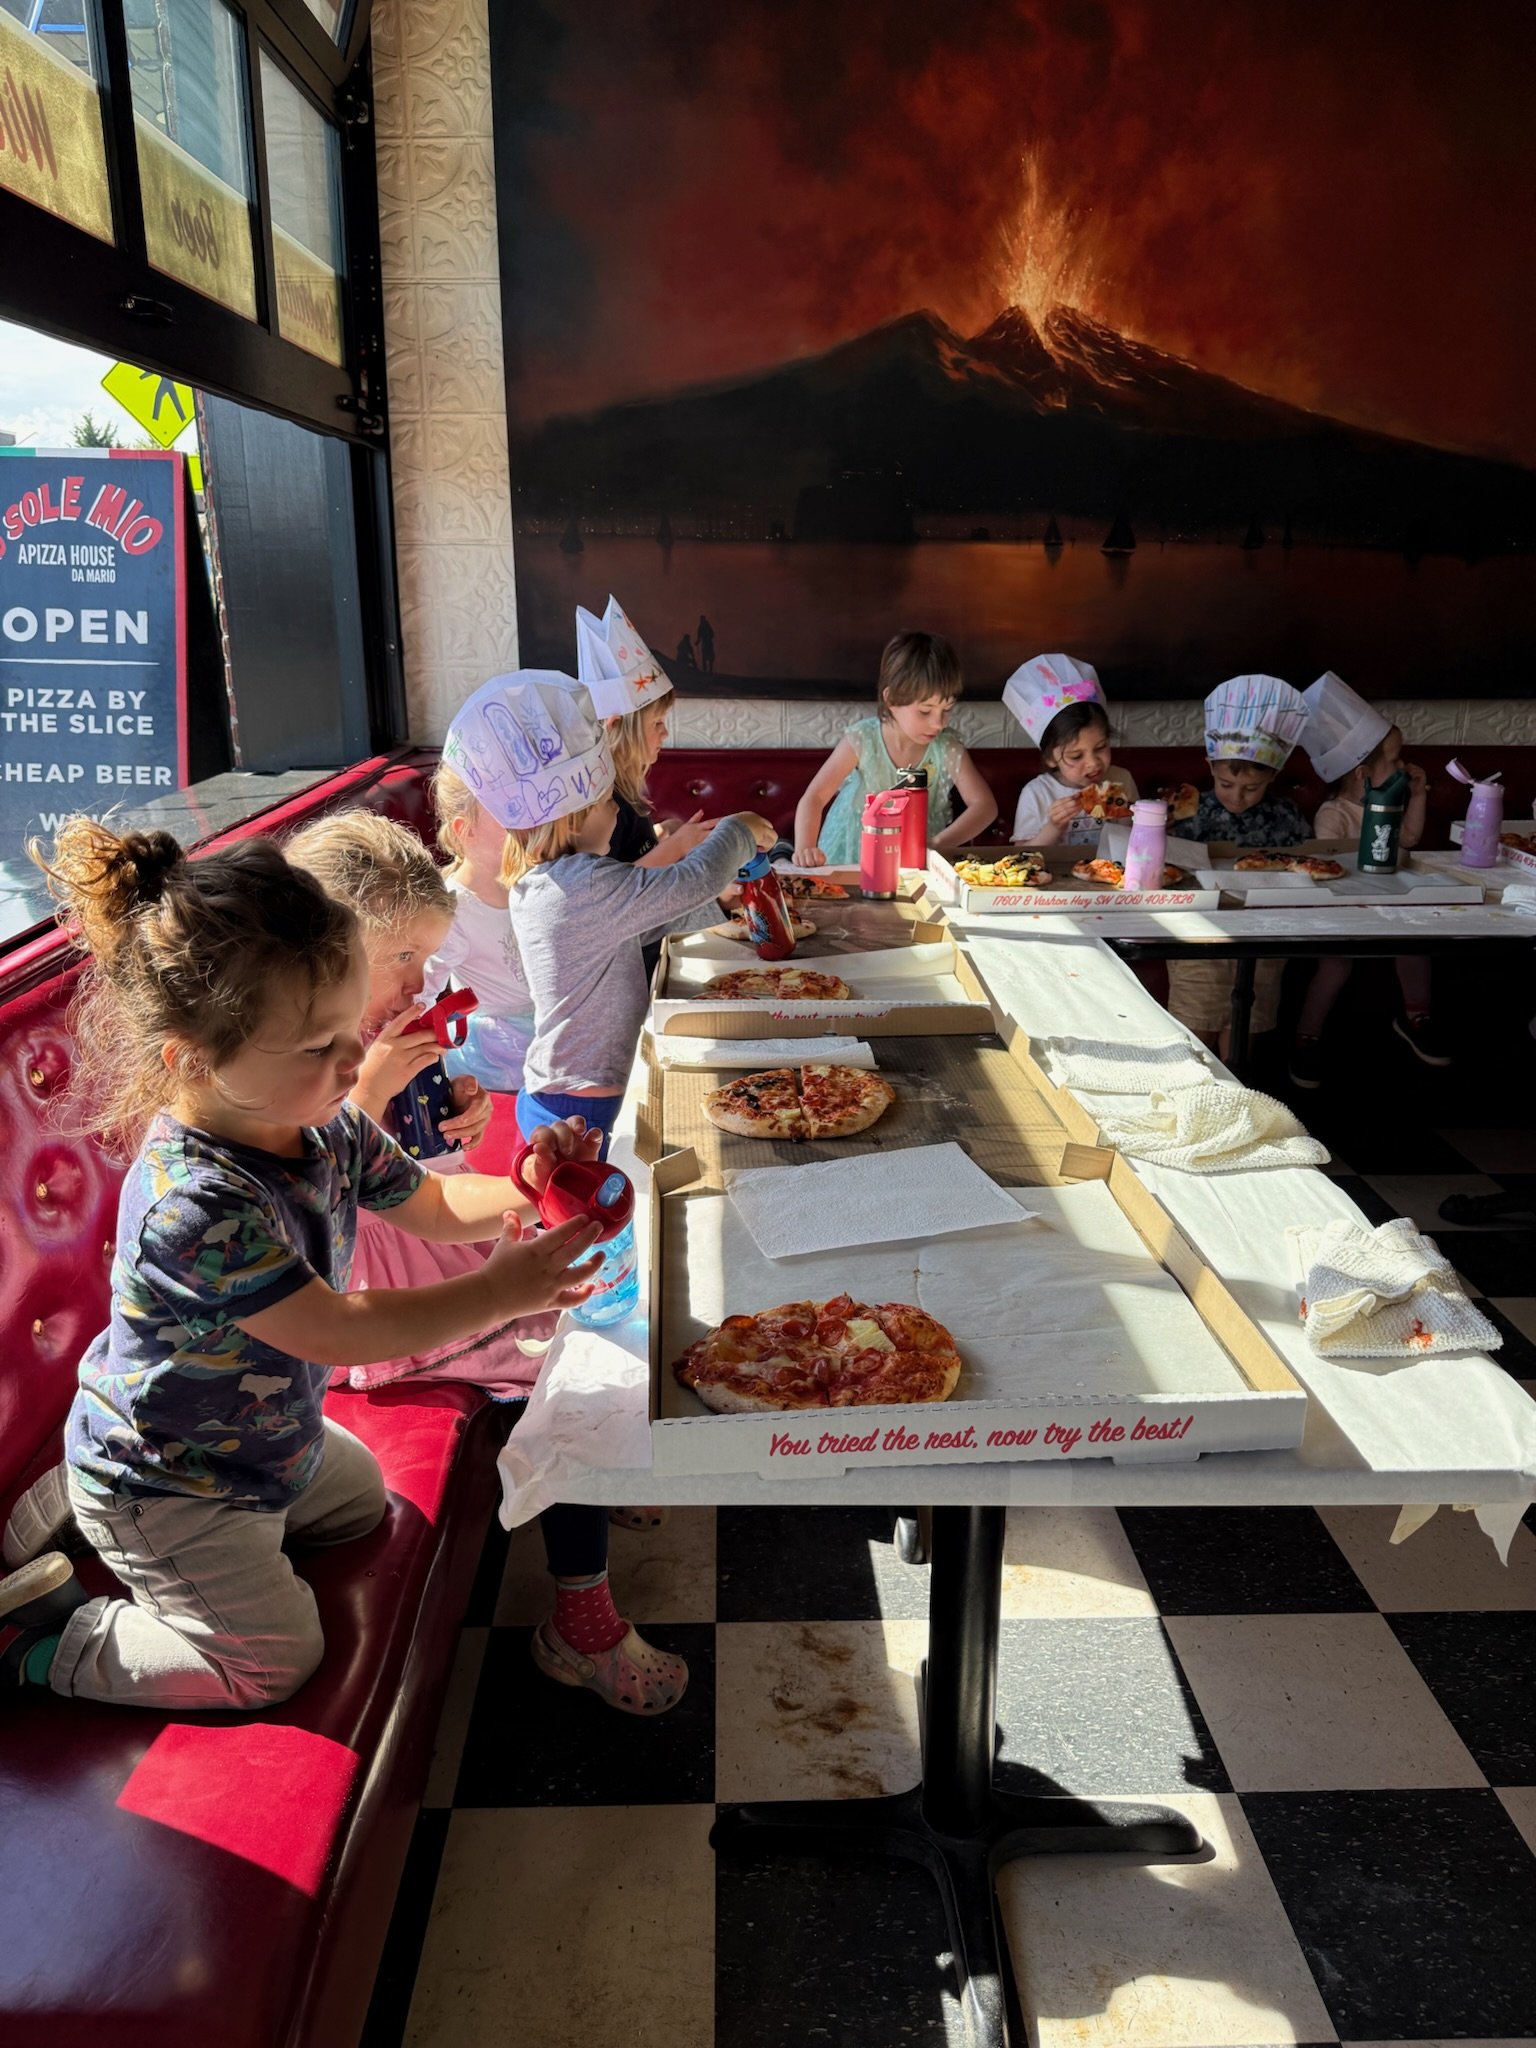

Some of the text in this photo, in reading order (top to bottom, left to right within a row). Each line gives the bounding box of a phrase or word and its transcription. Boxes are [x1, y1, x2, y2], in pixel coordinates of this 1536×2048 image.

[3, 476, 164, 556] SOLE MIO
[18, 543, 67, 566] APIZZA
[70, 544, 116, 567] HOUSE
[71, 568, 116, 584] DA MARIO
[2, 606, 149, 645] OPEN
[7, 687, 147, 710] PIZZA BY
[0, 712, 155, 736] THE SLICE
[0, 762, 173, 786] HEAP BEER
[992, 895, 1022, 906] 17607
[1033, 894, 1068, 906] Vashon
[1070, 894, 1092, 908] Hwy
[1094, 894, 1114, 905] SW
[1114, 893, 1143, 905] (206)
[1144, 893, 1195, 905] 408-7826
[769, 1414, 1195, 1457] You tried the rest, now try the best!
